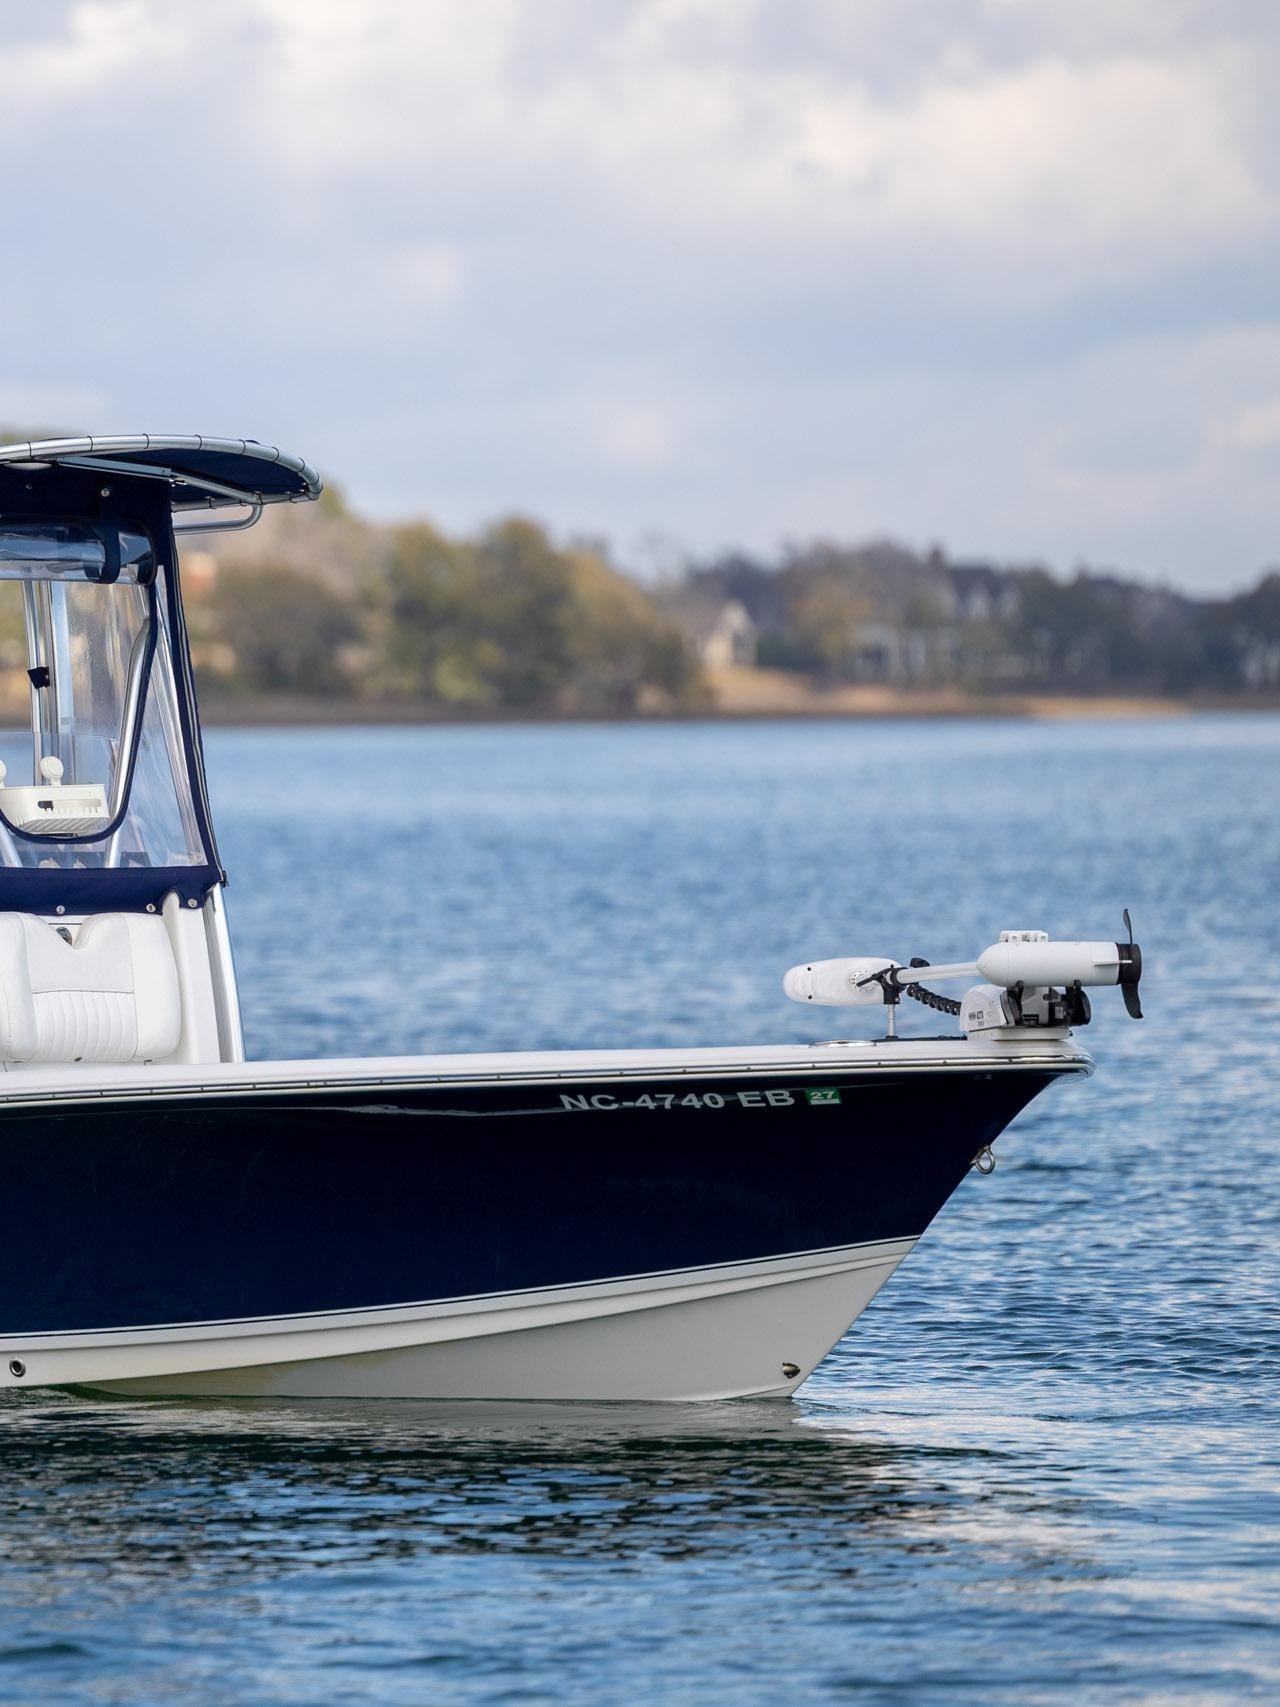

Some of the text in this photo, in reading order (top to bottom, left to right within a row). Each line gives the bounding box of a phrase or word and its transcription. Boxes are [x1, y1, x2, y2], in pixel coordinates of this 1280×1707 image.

[559, 1090, 795, 1110] NC-4740 EB
[810, 1091, 834, 1100] 27
